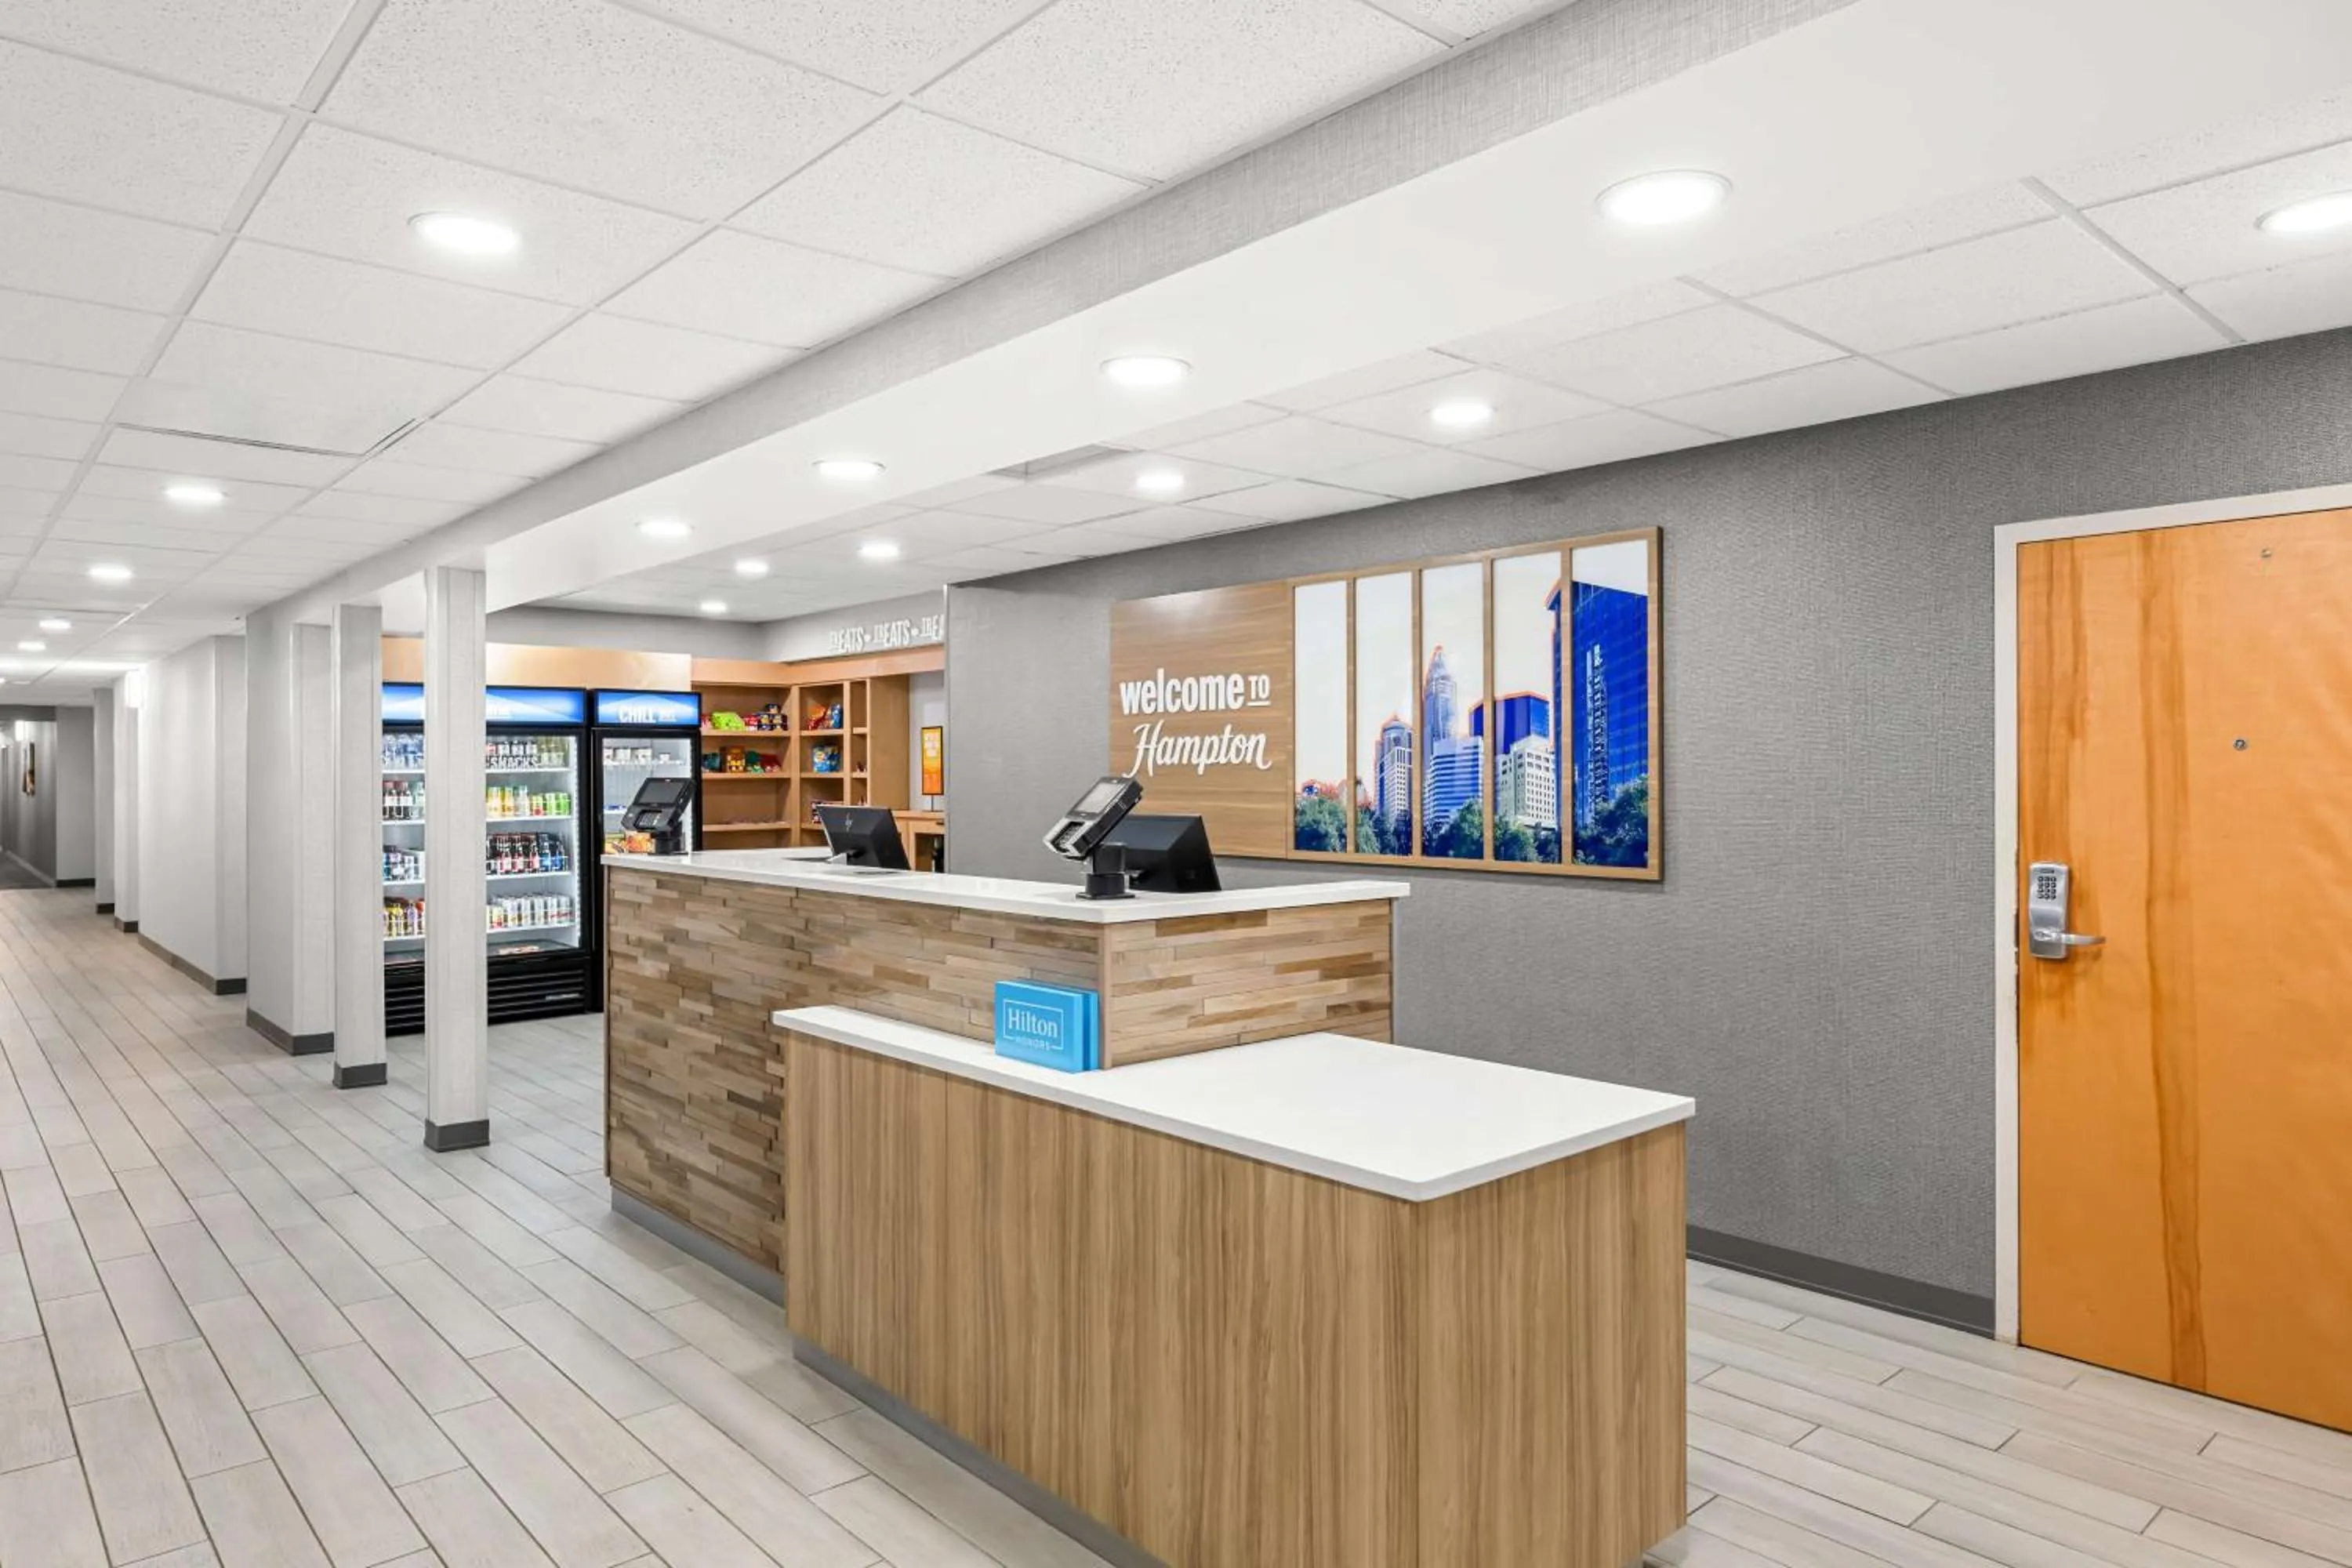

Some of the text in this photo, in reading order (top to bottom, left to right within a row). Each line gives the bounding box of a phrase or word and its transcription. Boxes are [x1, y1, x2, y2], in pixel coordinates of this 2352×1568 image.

[873, 619, 910, 646] TREATS
[1120, 668, 1271, 715] welcome TO
[618, 706, 656, 723] CHILL
[1122, 719, 1272, 779] Hampton
[1007, 1007, 1058, 1038] Hilton
